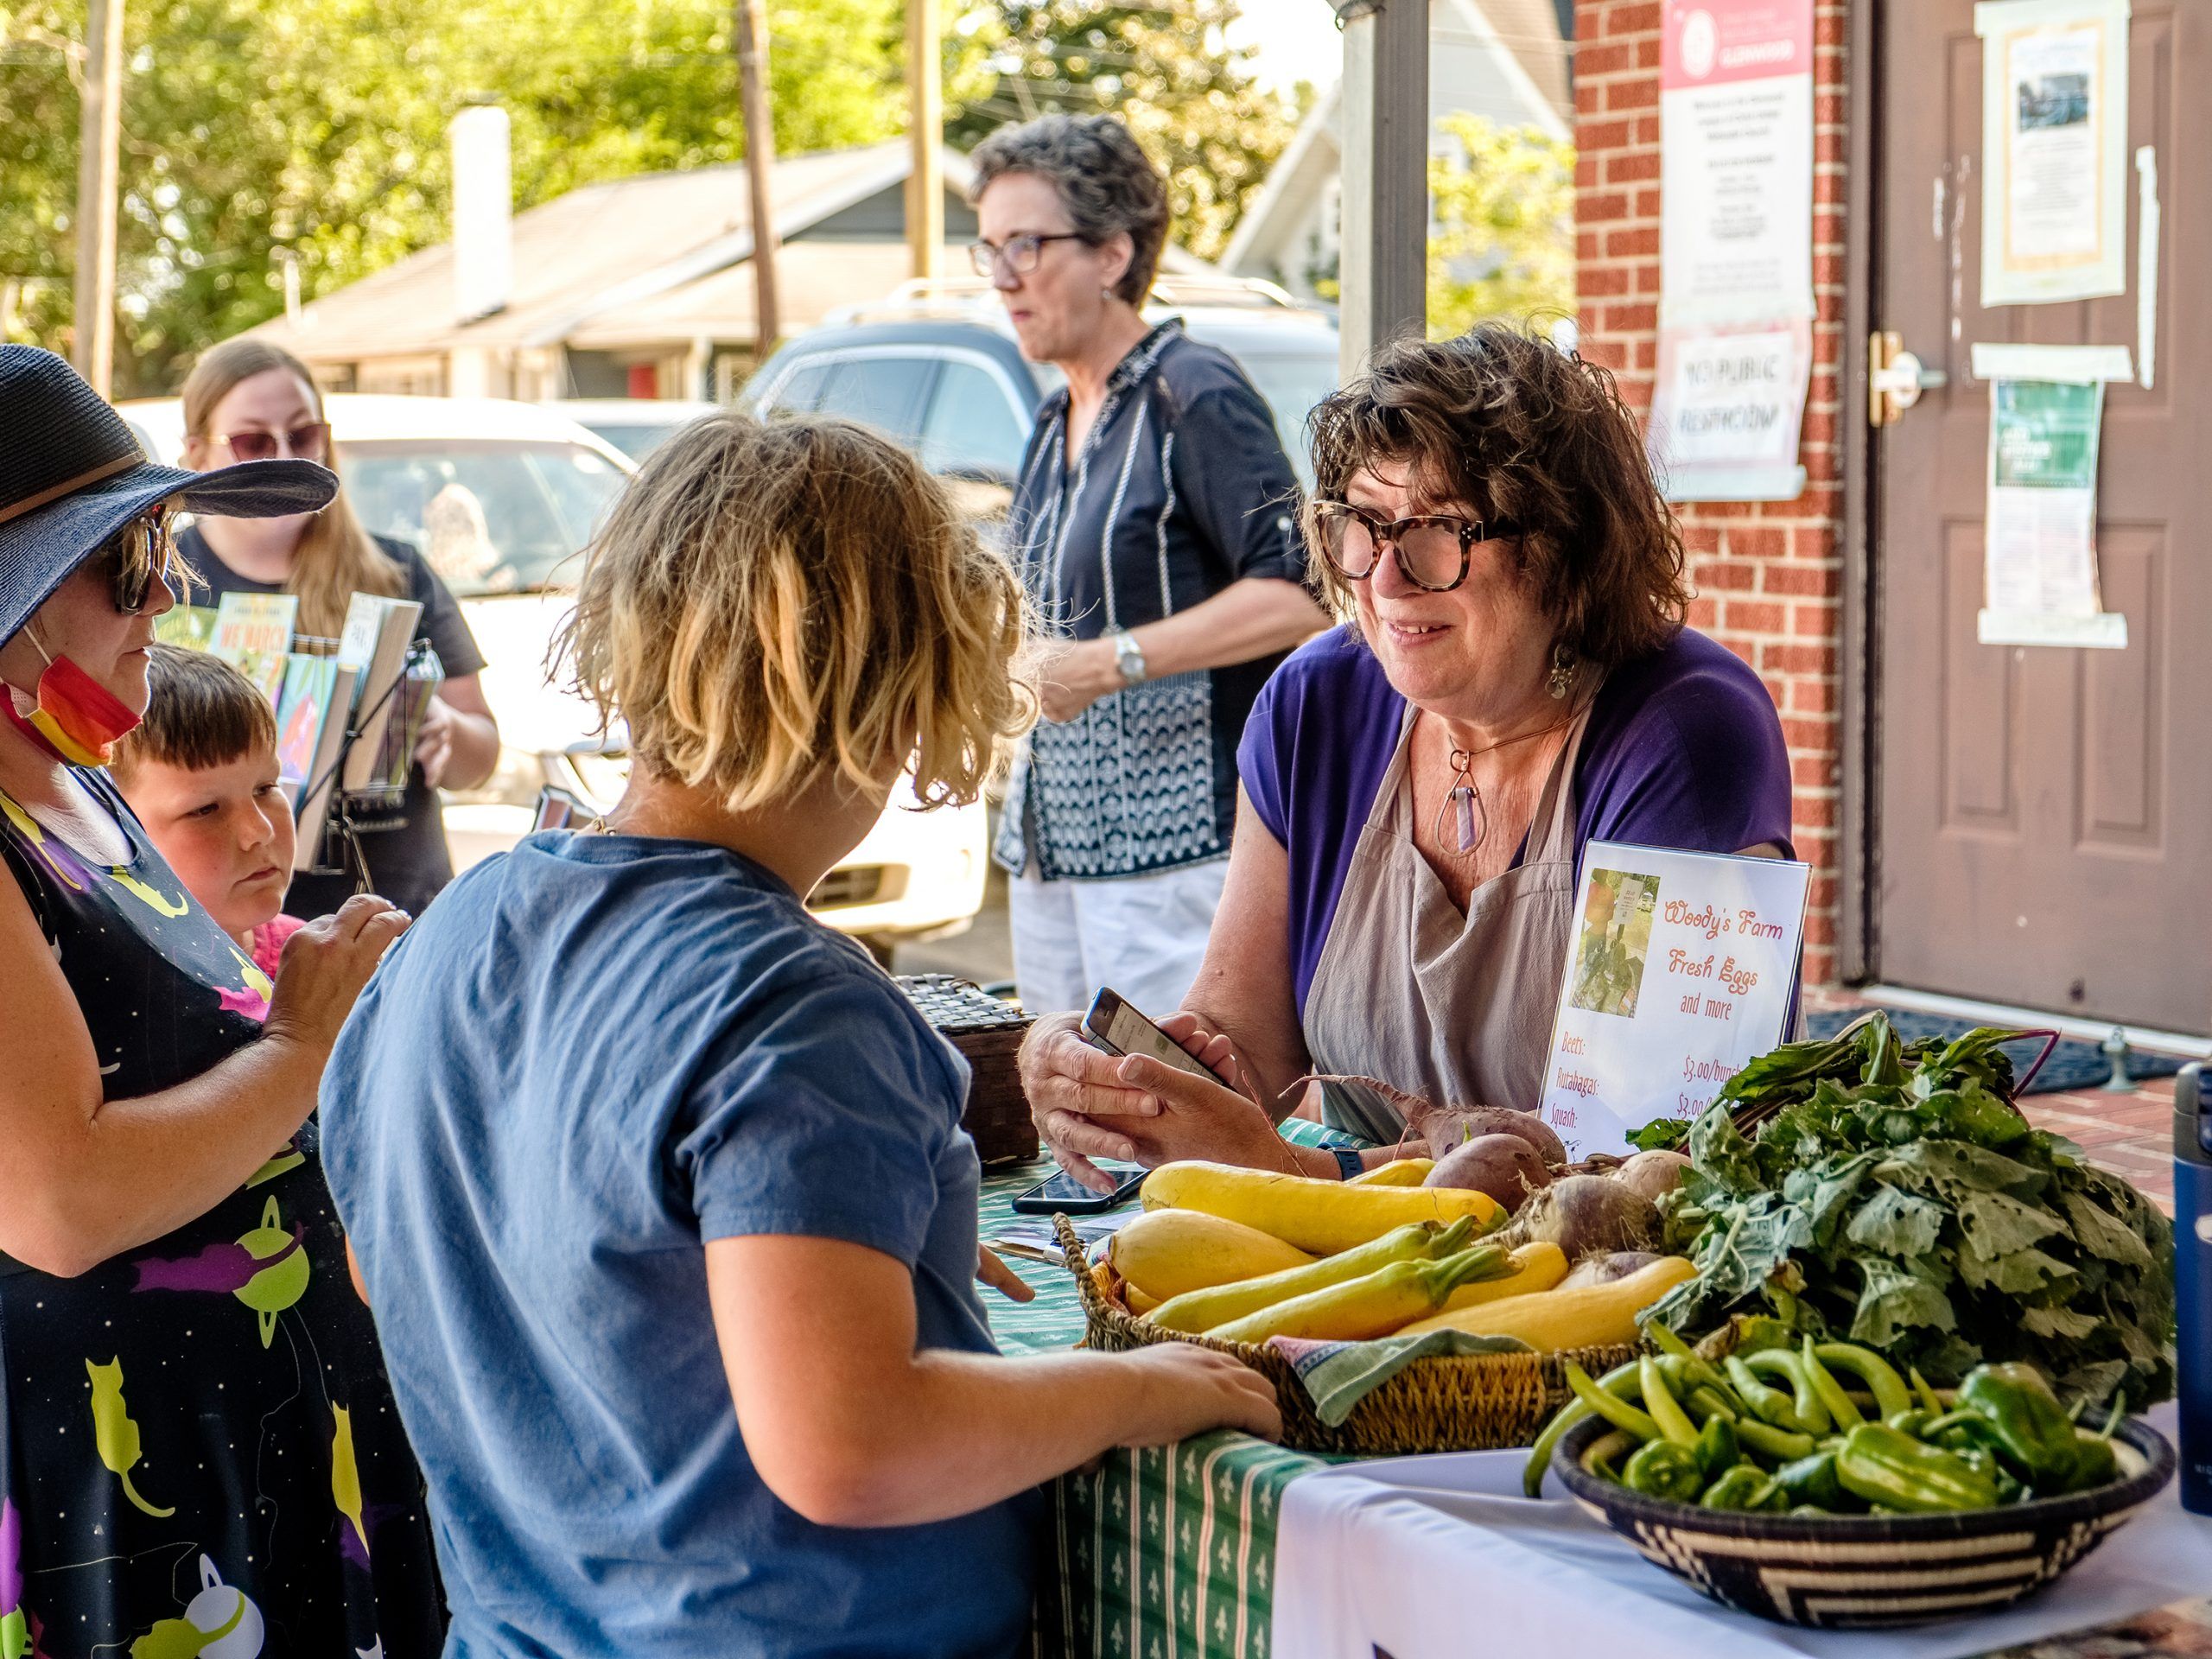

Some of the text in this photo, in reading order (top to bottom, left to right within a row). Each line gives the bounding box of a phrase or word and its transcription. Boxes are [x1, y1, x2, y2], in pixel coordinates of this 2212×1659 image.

[1716, 354, 1780, 385] PUBLIC
[1664, 899, 1731, 940] Woody's
[1738, 910, 1783, 939] Farm
[1669, 949, 1758, 995] Fresh Eggs
[1681, 992, 1732, 1020] and more
[1561, 1031, 1586, 1055] Beets:
[1556, 1066, 1599, 1097] Rutabagas:
[1550, 1103, 1578, 1128] Squash:
